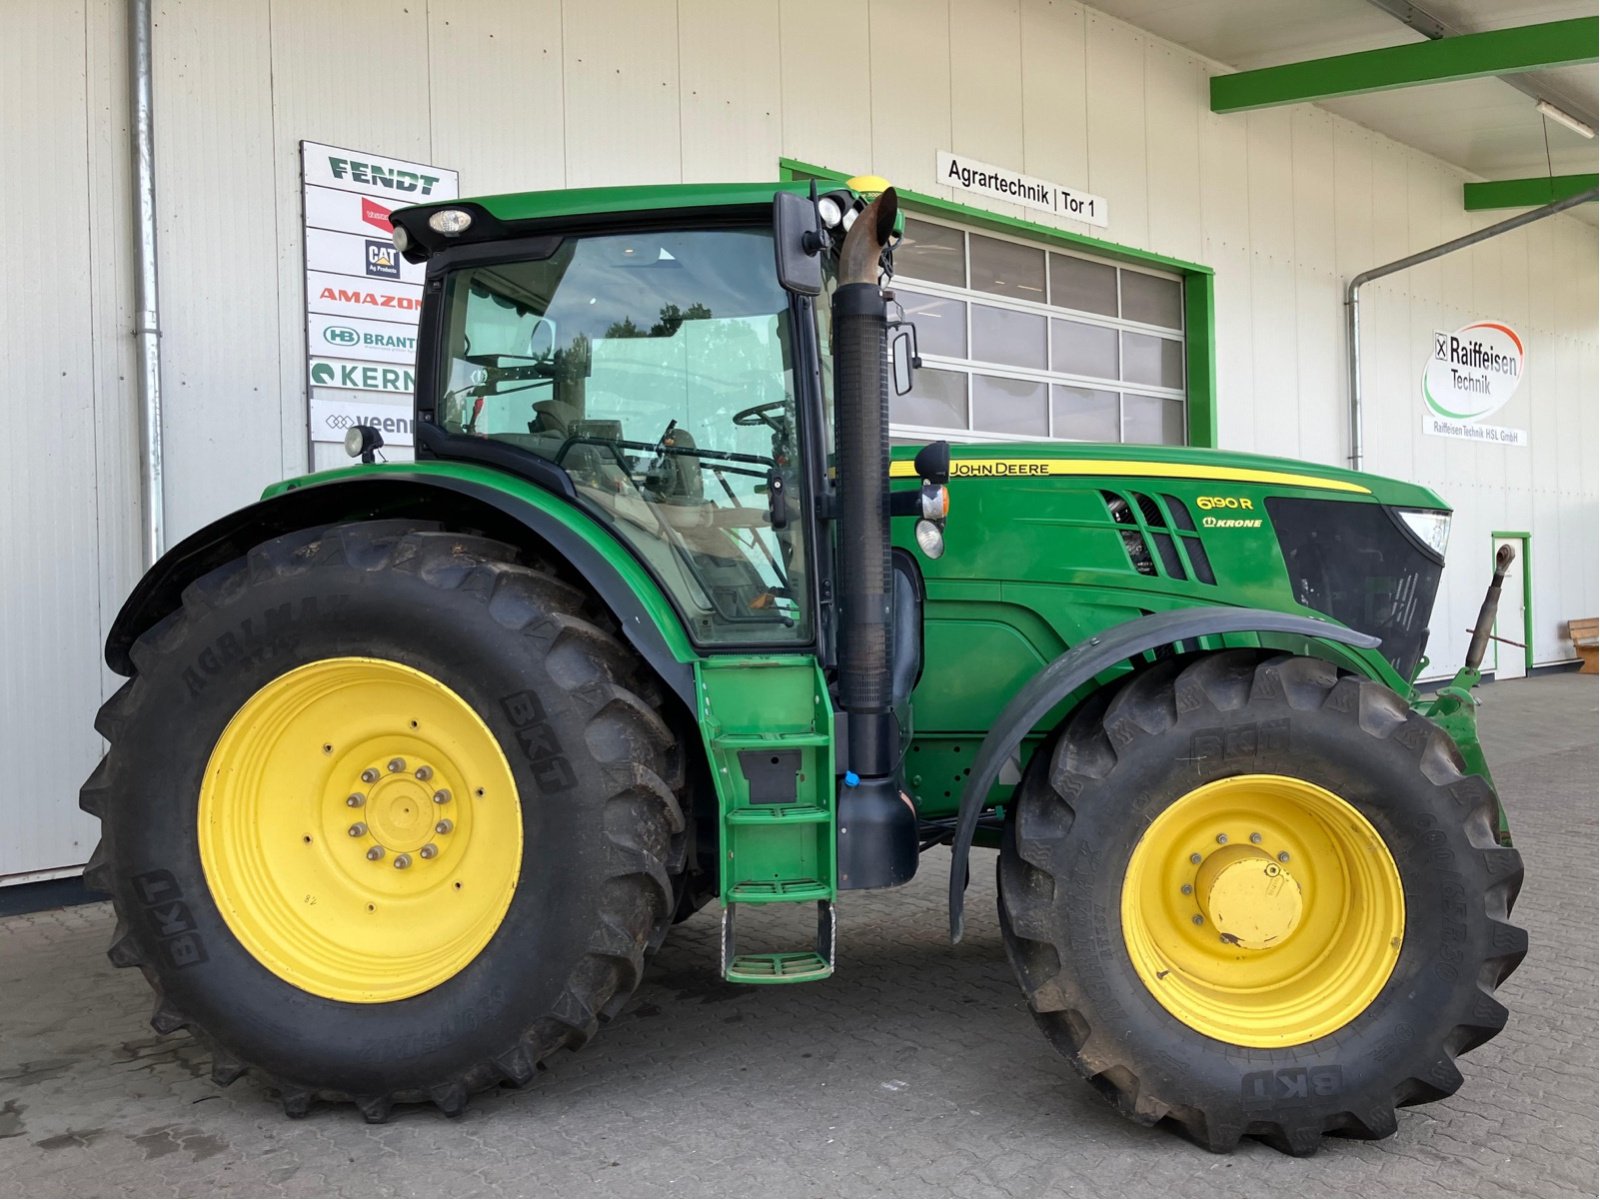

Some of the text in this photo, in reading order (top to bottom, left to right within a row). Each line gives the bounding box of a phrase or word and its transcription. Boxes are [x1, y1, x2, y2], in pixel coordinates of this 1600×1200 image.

[328, 156, 440, 195] FENDT
[948, 159, 1050, 205] Agrartechnik
[1061, 191, 1084, 214] Tor
[1088, 199, 1095, 217] 1
[368, 245, 397, 266] CAT
[363, 333, 416, 348] BRANT
[1450, 336, 1517, 377] Raiffeisen
[341, 365, 415, 391] KERN
[1451, 368, 1491, 395] Technik
[1485, 428, 1499, 440] HSL
[1500, 430, 1518, 442] GmbH
[950, 462, 1050, 475] JOHN DEERE
[1196, 496, 1255, 510] 6190 R
[1216, 519, 1263, 528] KRONE
[502, 691, 575, 792] BKT
[135, 872, 206, 968] BKT
[1242, 1068, 1340, 1104] BKT
